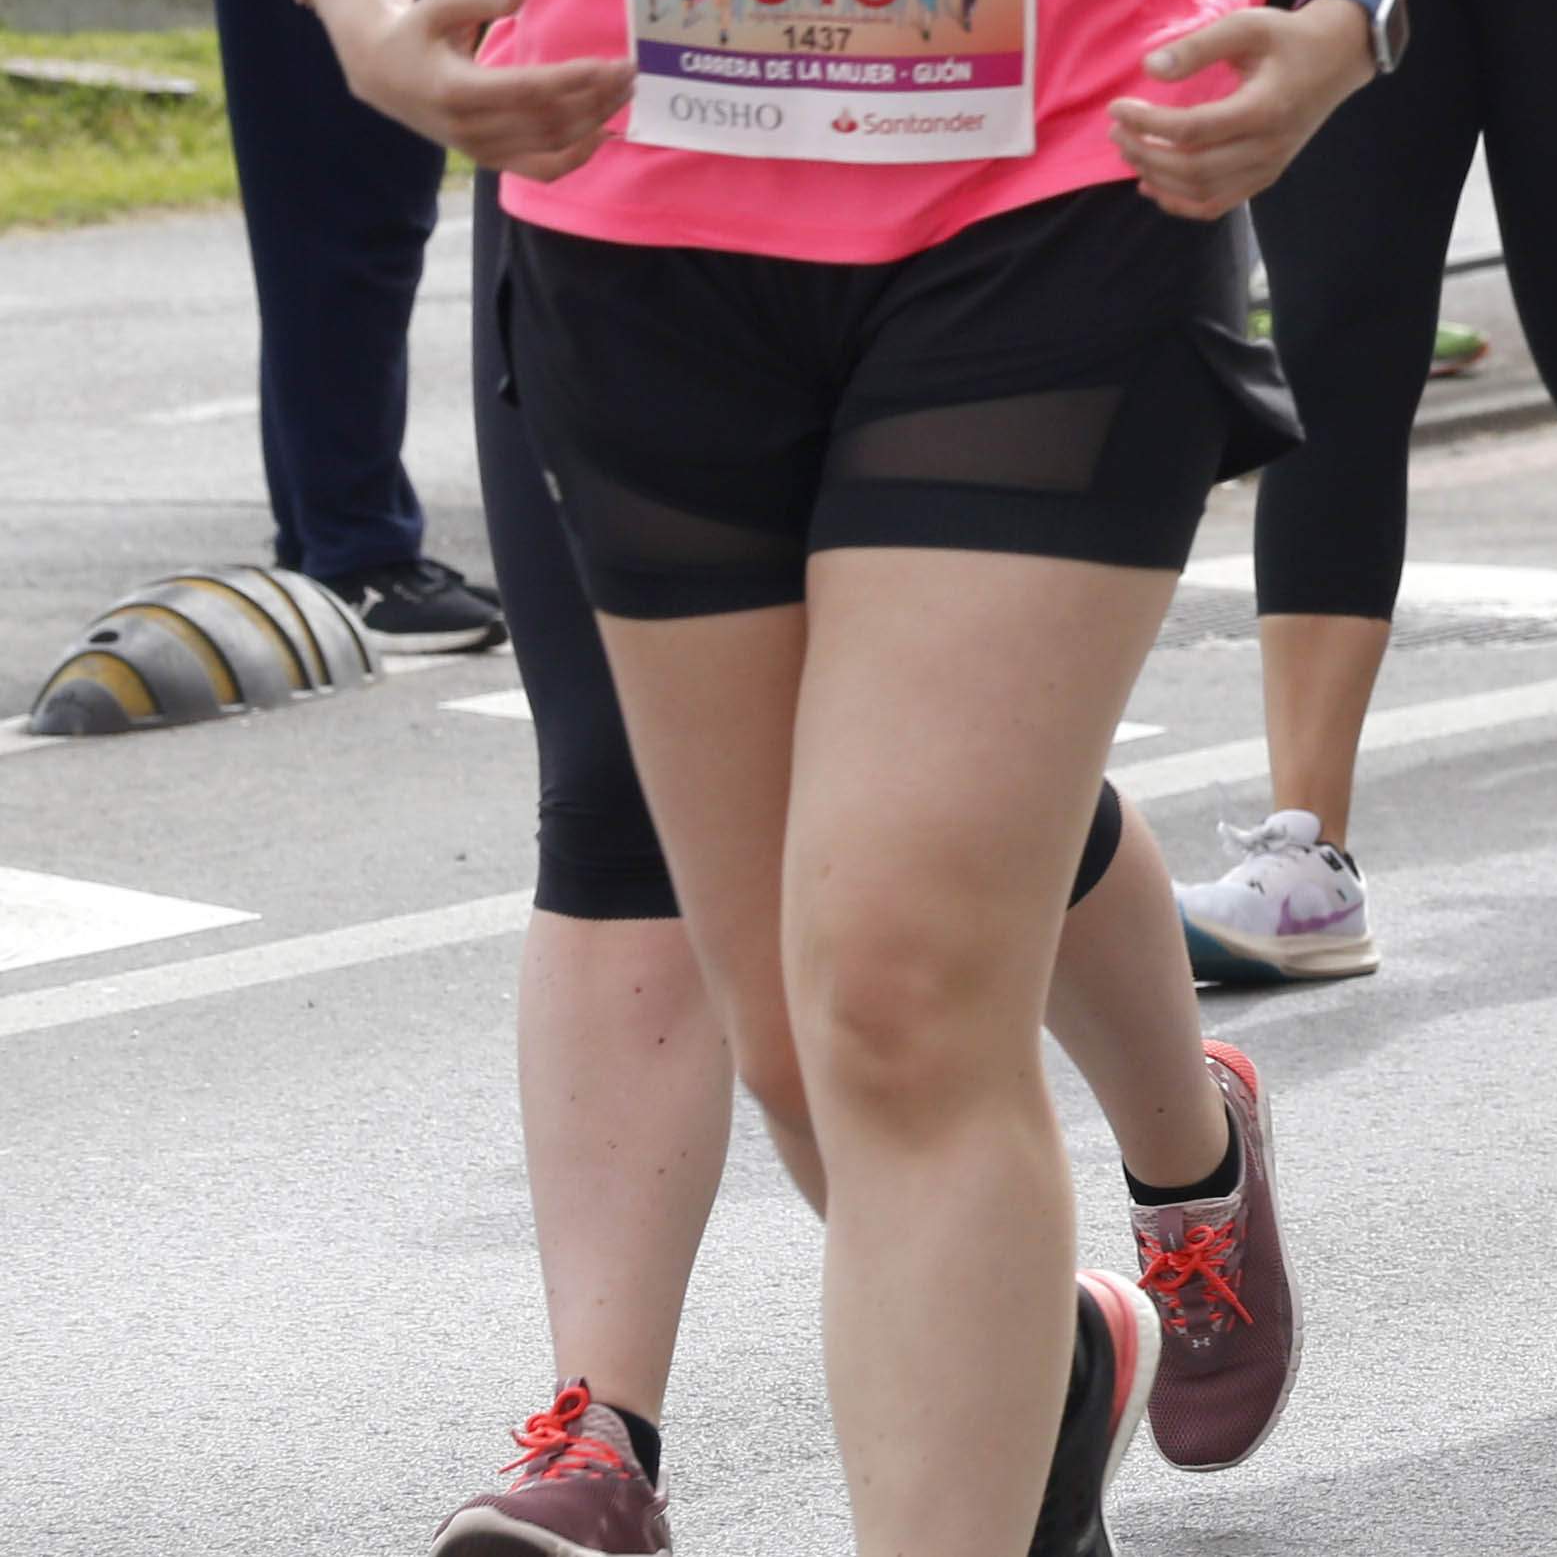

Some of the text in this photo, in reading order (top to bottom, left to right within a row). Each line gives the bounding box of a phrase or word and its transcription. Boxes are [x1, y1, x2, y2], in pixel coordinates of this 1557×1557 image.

[783, 25, 852, 52] 1437
[680, 52, 761, 79] CARRERA
[765, 60, 793, 81] DE
[800, 60, 823, 81] LA
[827, 61, 896, 84] MUJER
[669, 92, 784, 131] OYSHO
[863, 111, 987, 135] Santander
